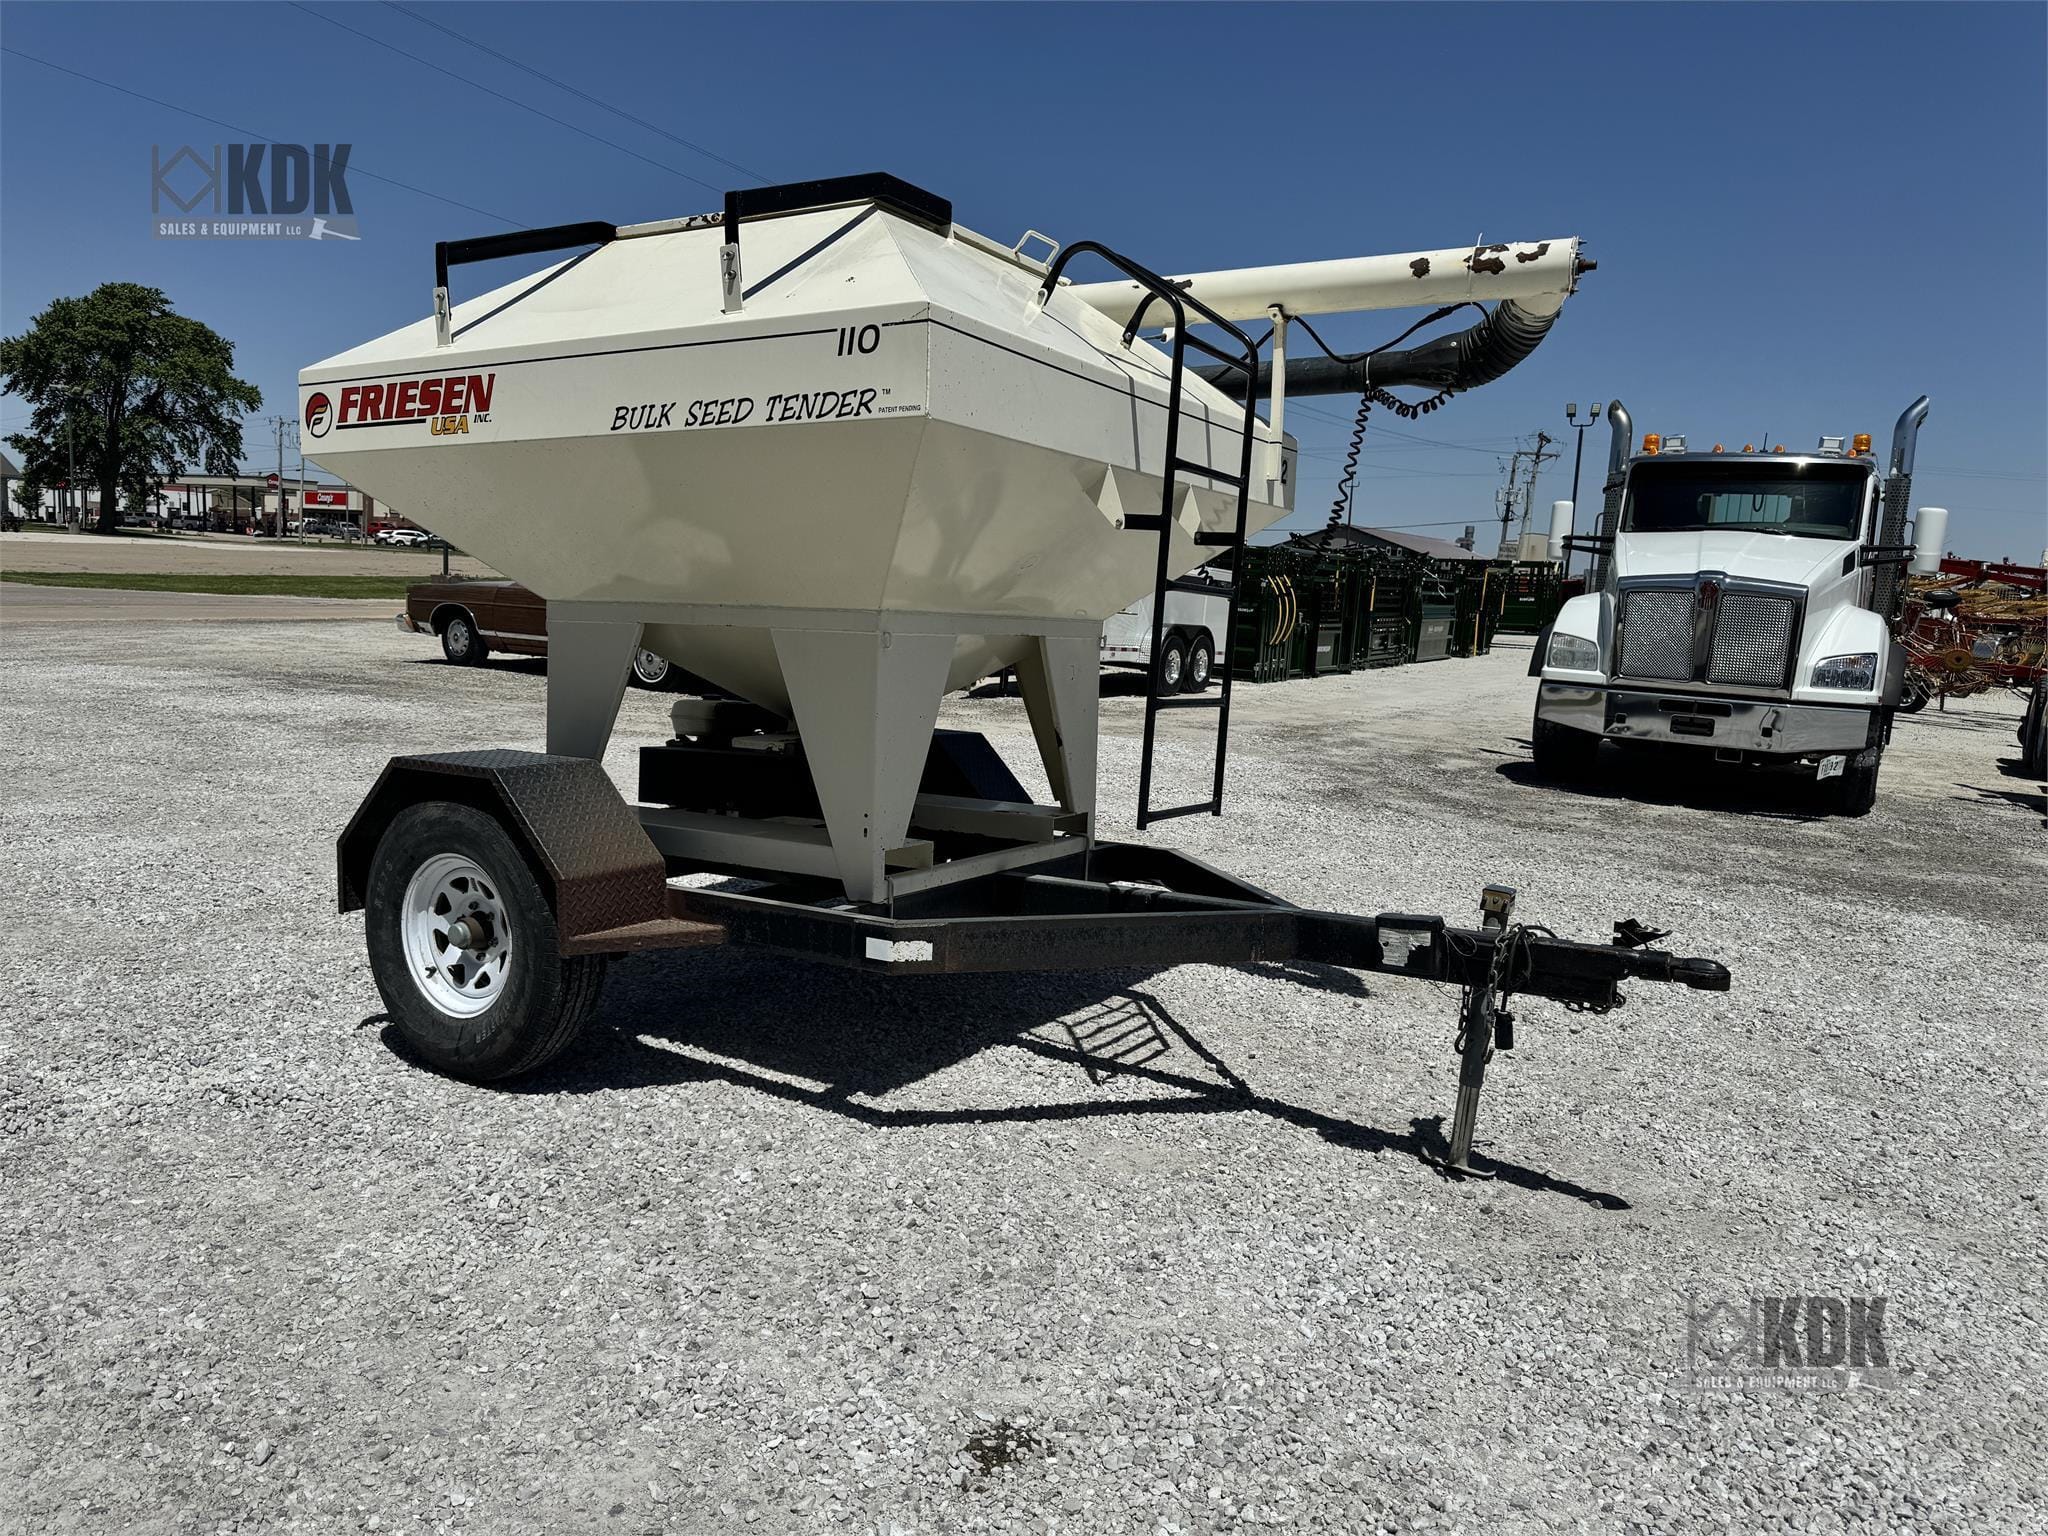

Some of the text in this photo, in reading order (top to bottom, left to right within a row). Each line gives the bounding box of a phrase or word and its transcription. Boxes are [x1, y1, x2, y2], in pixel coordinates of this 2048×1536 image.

[837, 324, 880, 357] 110
[337, 373, 496, 424] FRIESEN
[610, 401, 677, 432] BULK
[684, 396, 755, 428] SEED
[766, 387, 878, 423] TENDER
[878, 404, 921, 414] PATENT PENDING
[431, 413, 492, 436] USA INC.
